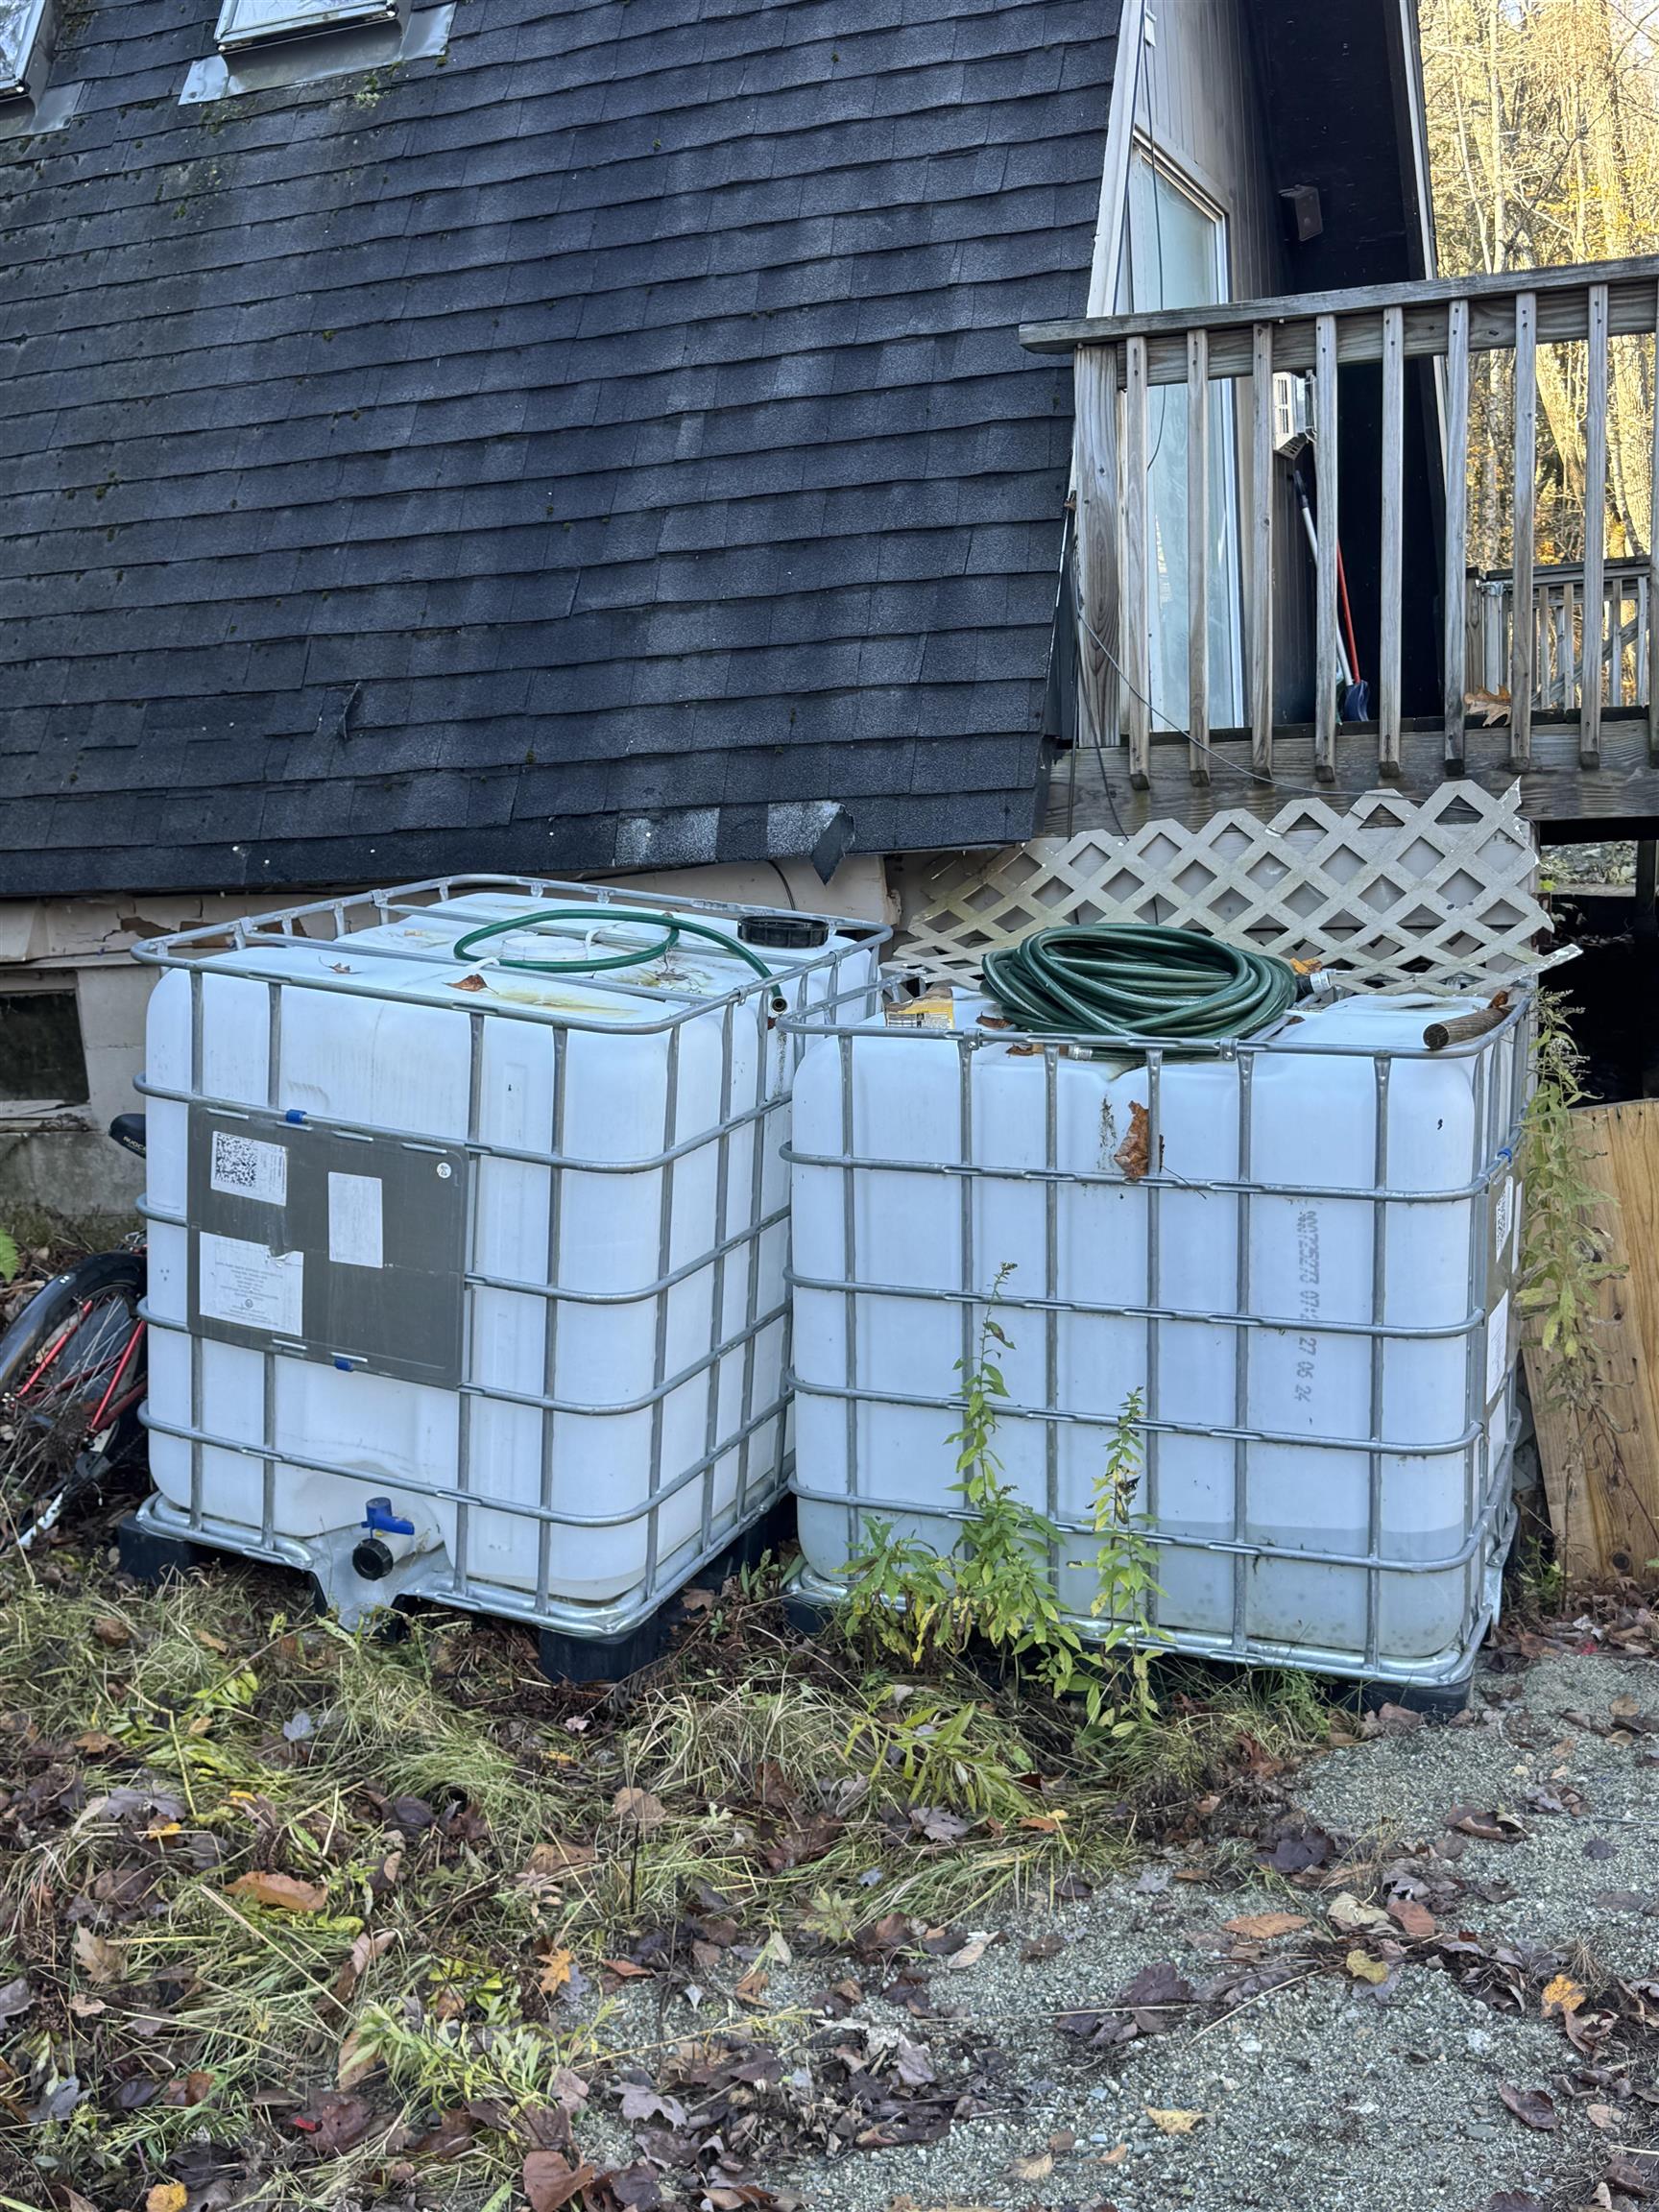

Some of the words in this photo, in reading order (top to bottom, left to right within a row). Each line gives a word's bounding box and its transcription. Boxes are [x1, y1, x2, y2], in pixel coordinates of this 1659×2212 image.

[1299, 1290, 1320, 1320] 07:2
[1298, 1335, 1317, 1357] 27
[1293, 1384, 1311, 1403] 24
